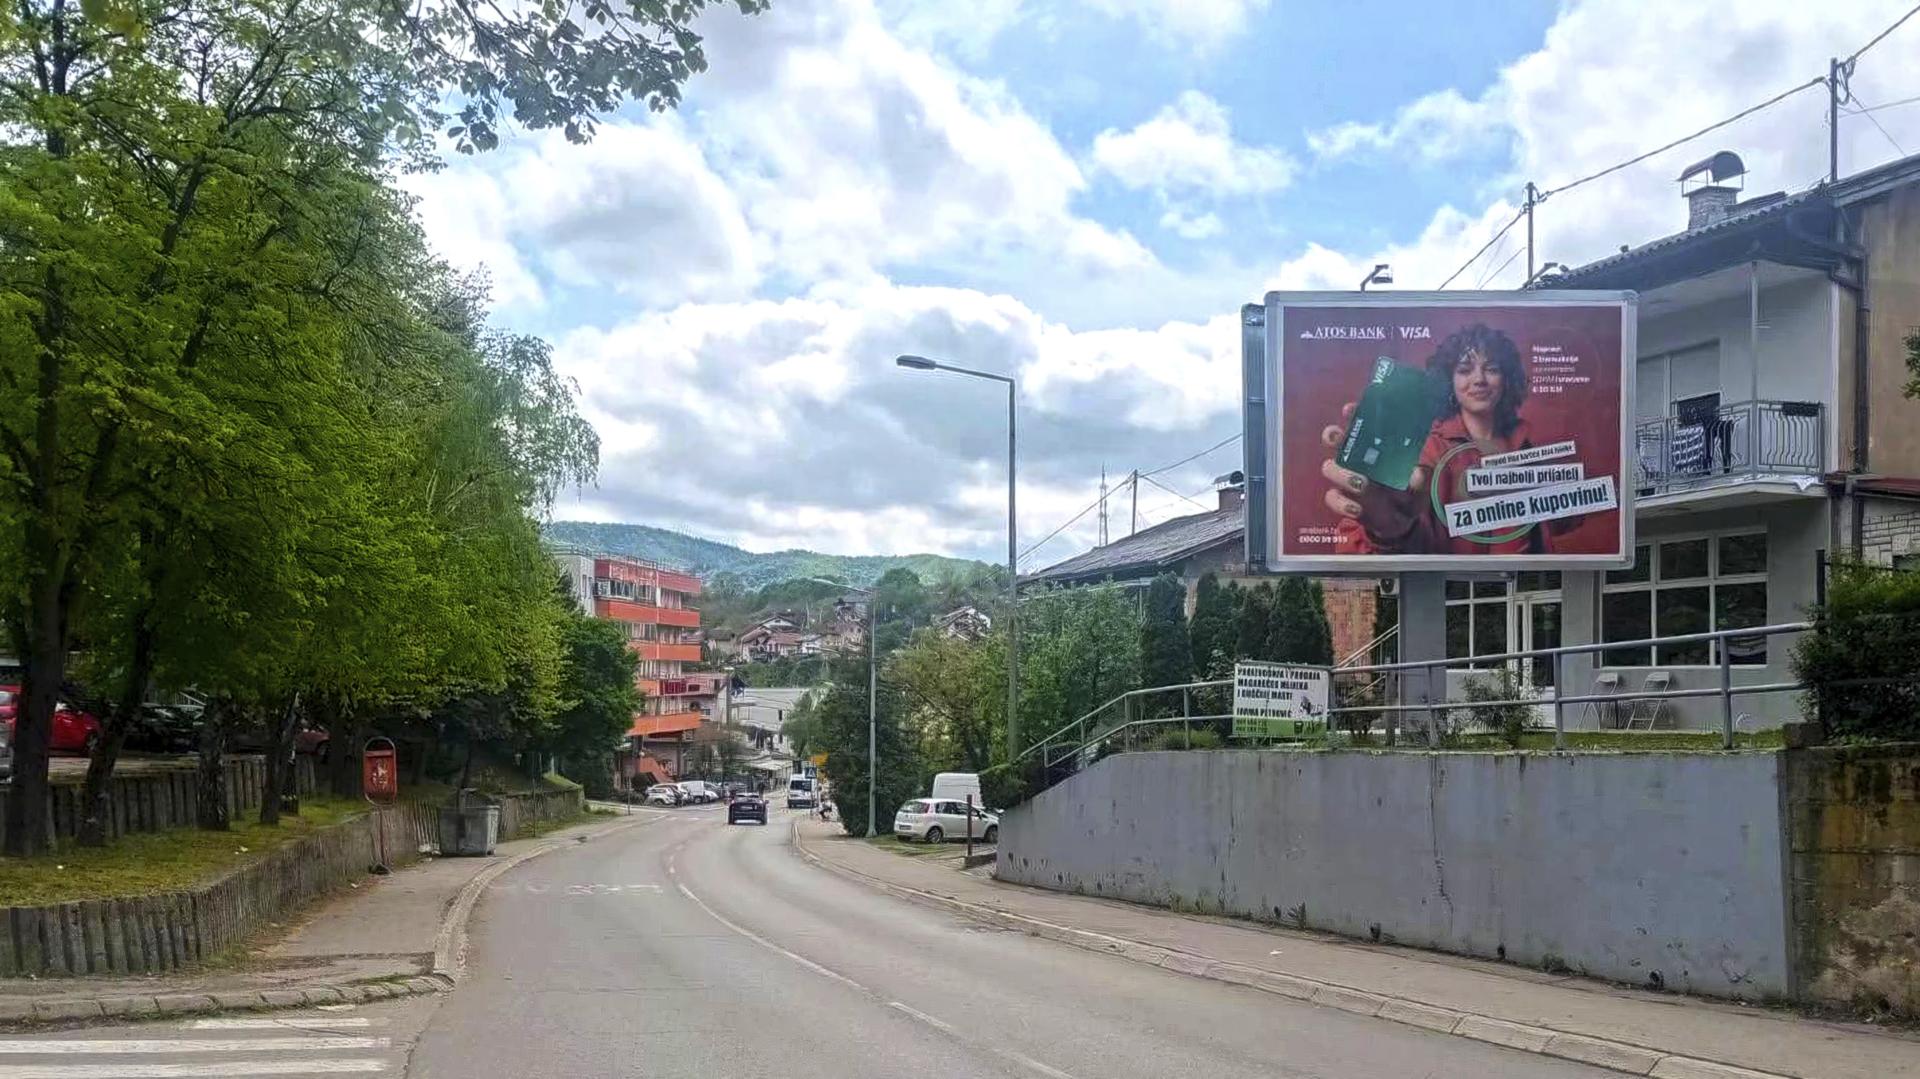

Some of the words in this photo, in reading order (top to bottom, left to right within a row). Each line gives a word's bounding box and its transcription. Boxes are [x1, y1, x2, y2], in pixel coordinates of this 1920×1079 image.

[1314, 326, 1347, 340] ATOS
[1350, 326, 1386, 340] BANK
[1399, 326, 1431, 339] VISA
[1372, 358, 1392, 385] VISA
[1470, 471, 1493, 487] Tvoj
[1495, 469, 1535, 486] najbolji
[1537, 466, 1579, 484] prijatelj
[1453, 510, 1473, 528] za
[1476, 499, 1526, 523] online
[1529, 484, 1609, 514] kupovinu!
